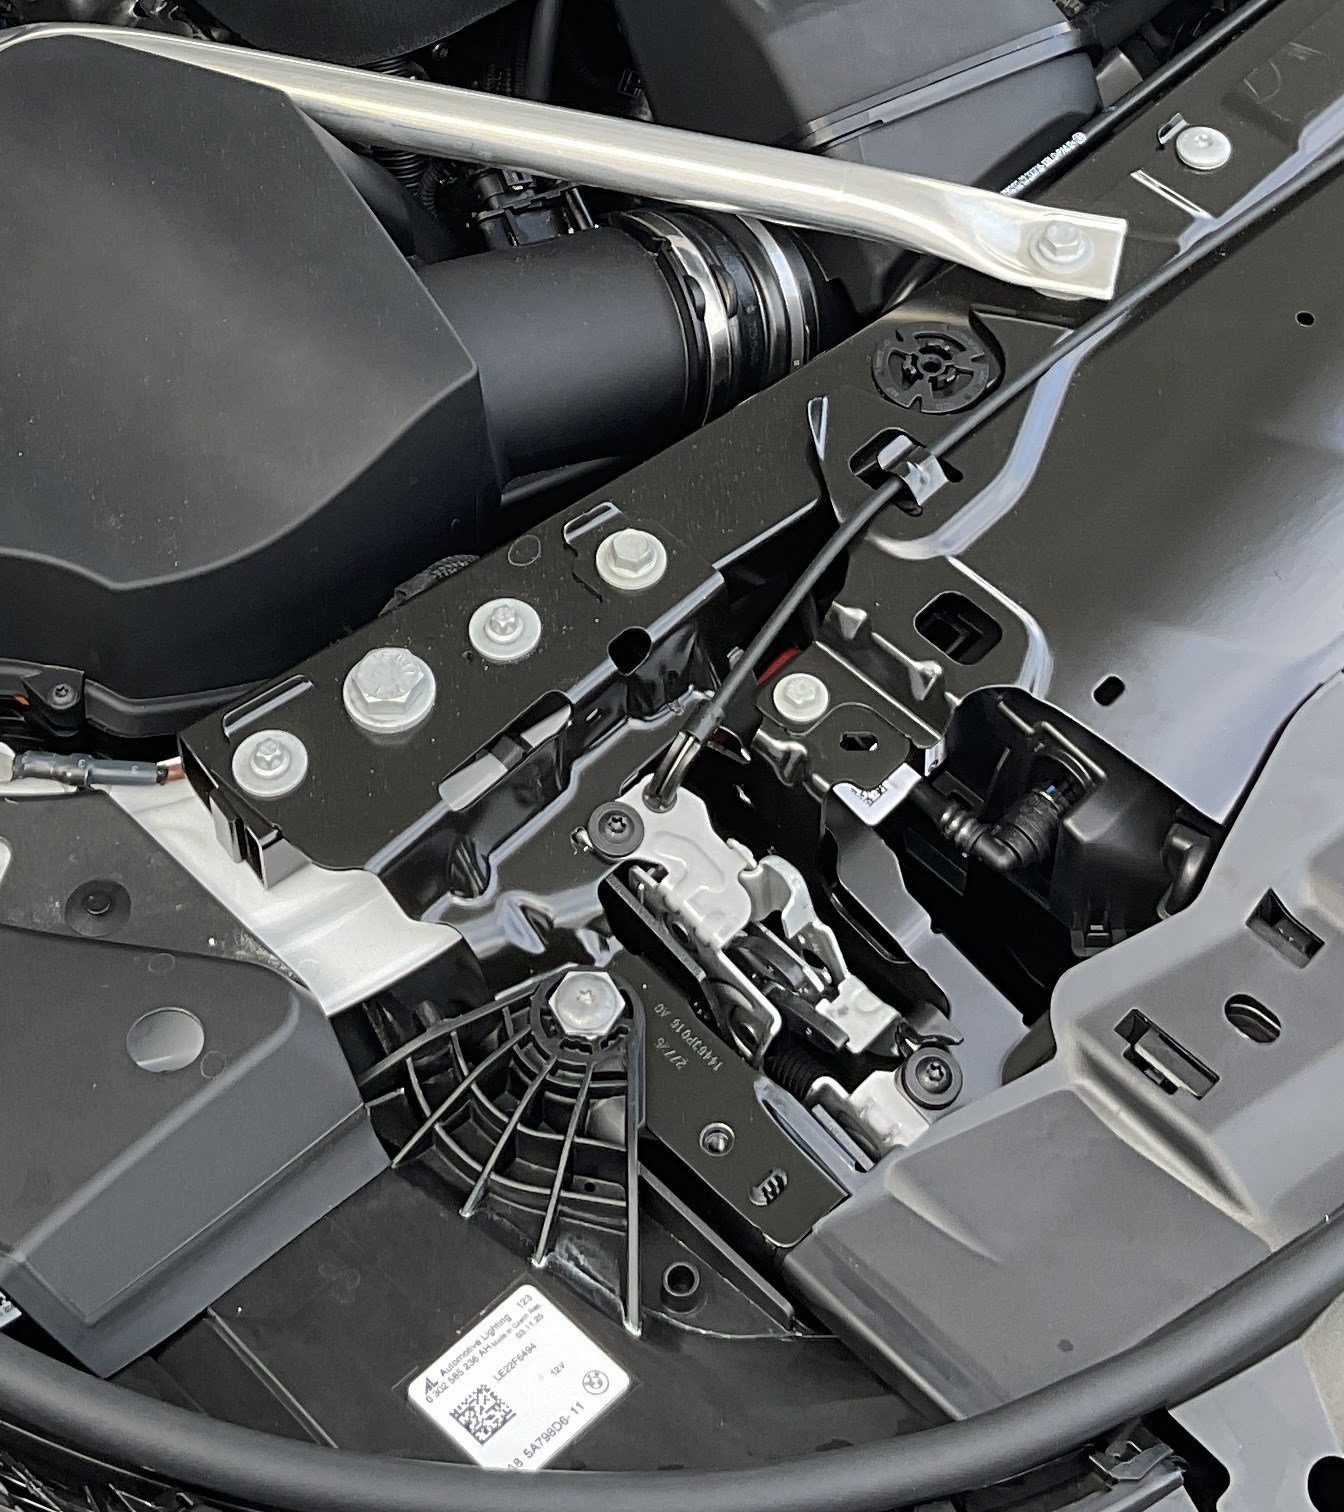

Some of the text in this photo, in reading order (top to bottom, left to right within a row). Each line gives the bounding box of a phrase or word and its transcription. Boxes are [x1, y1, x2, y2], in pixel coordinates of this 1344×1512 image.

[440, 1339, 482, 1377] Automotive
[480, 1314, 512, 1341] Lighting
[517, 1294, 532, 1308] 123
[433, 1382, 448, 1397] 302
